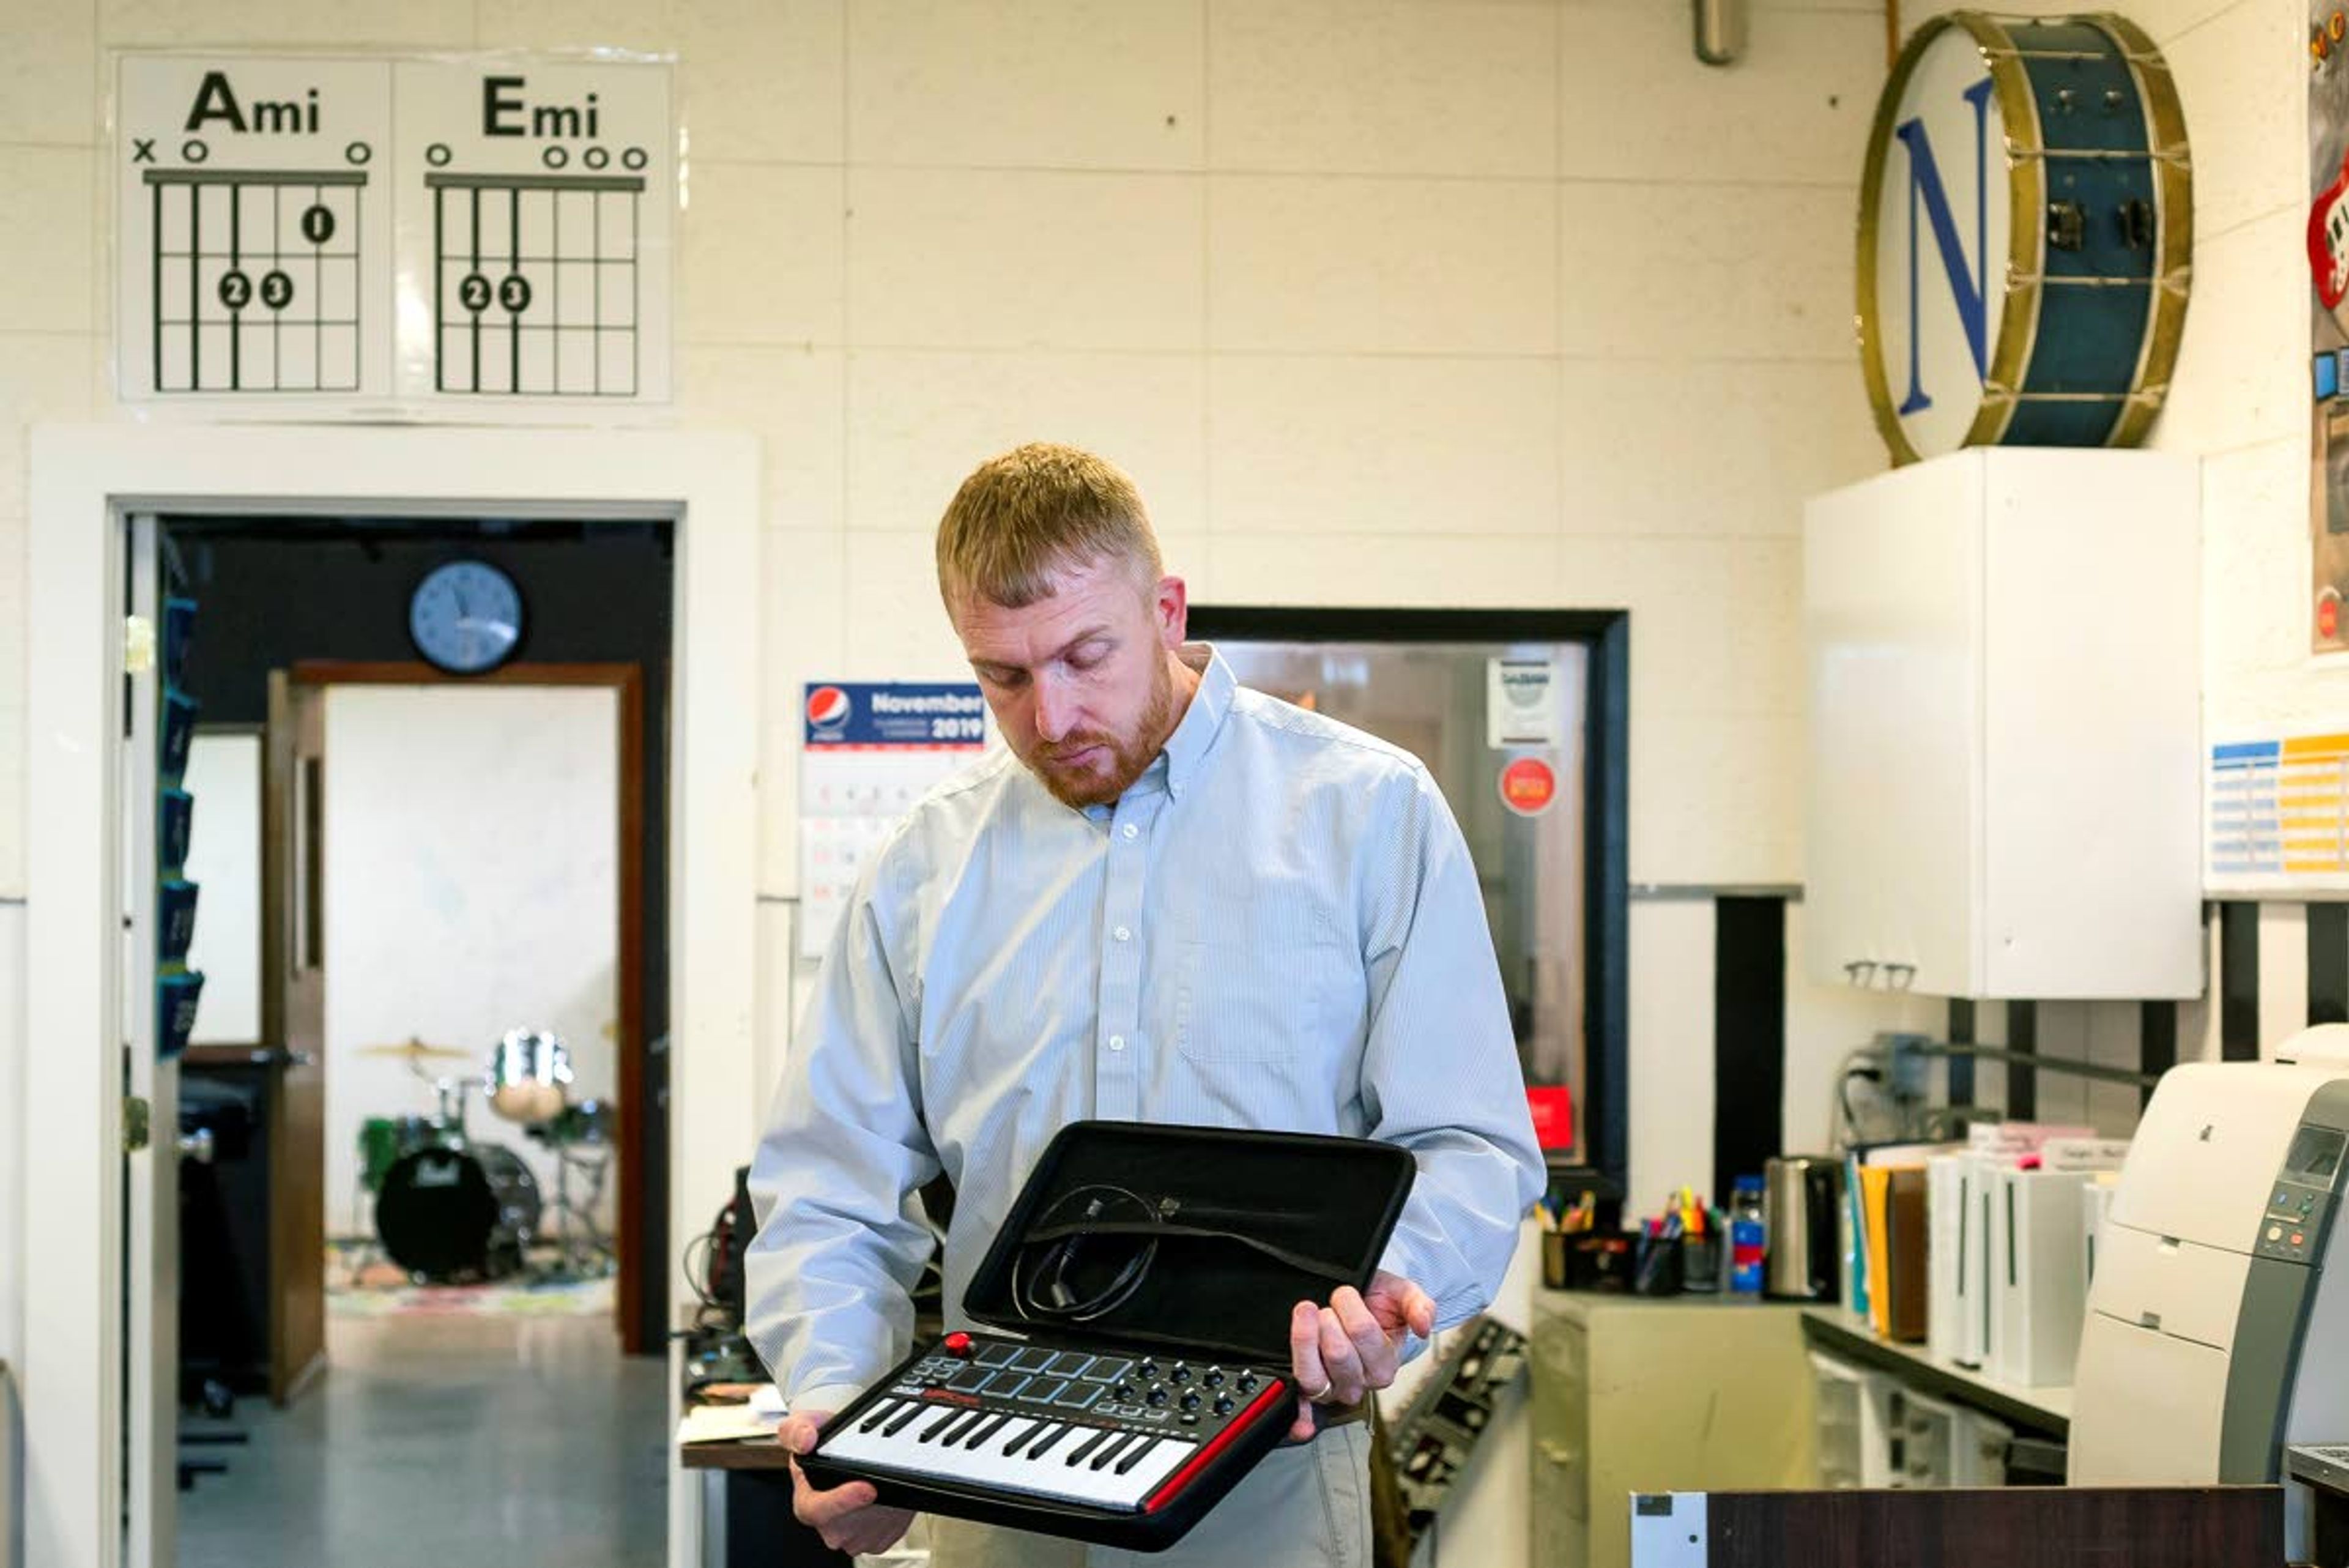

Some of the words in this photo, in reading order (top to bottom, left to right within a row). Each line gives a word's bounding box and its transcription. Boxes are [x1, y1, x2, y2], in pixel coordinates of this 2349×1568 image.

[185, 71, 319, 133] Ami
[483, 76, 598, 138] Emi
[1896, 76, 1994, 416] N
[225, 277, 245, 302] 2
[267, 277, 285, 303] 3
[466, 281, 485, 306] 2
[507, 281, 523, 306] 3
[870, 693, 982, 713] November
[932, 718, 982, 738] 2019
